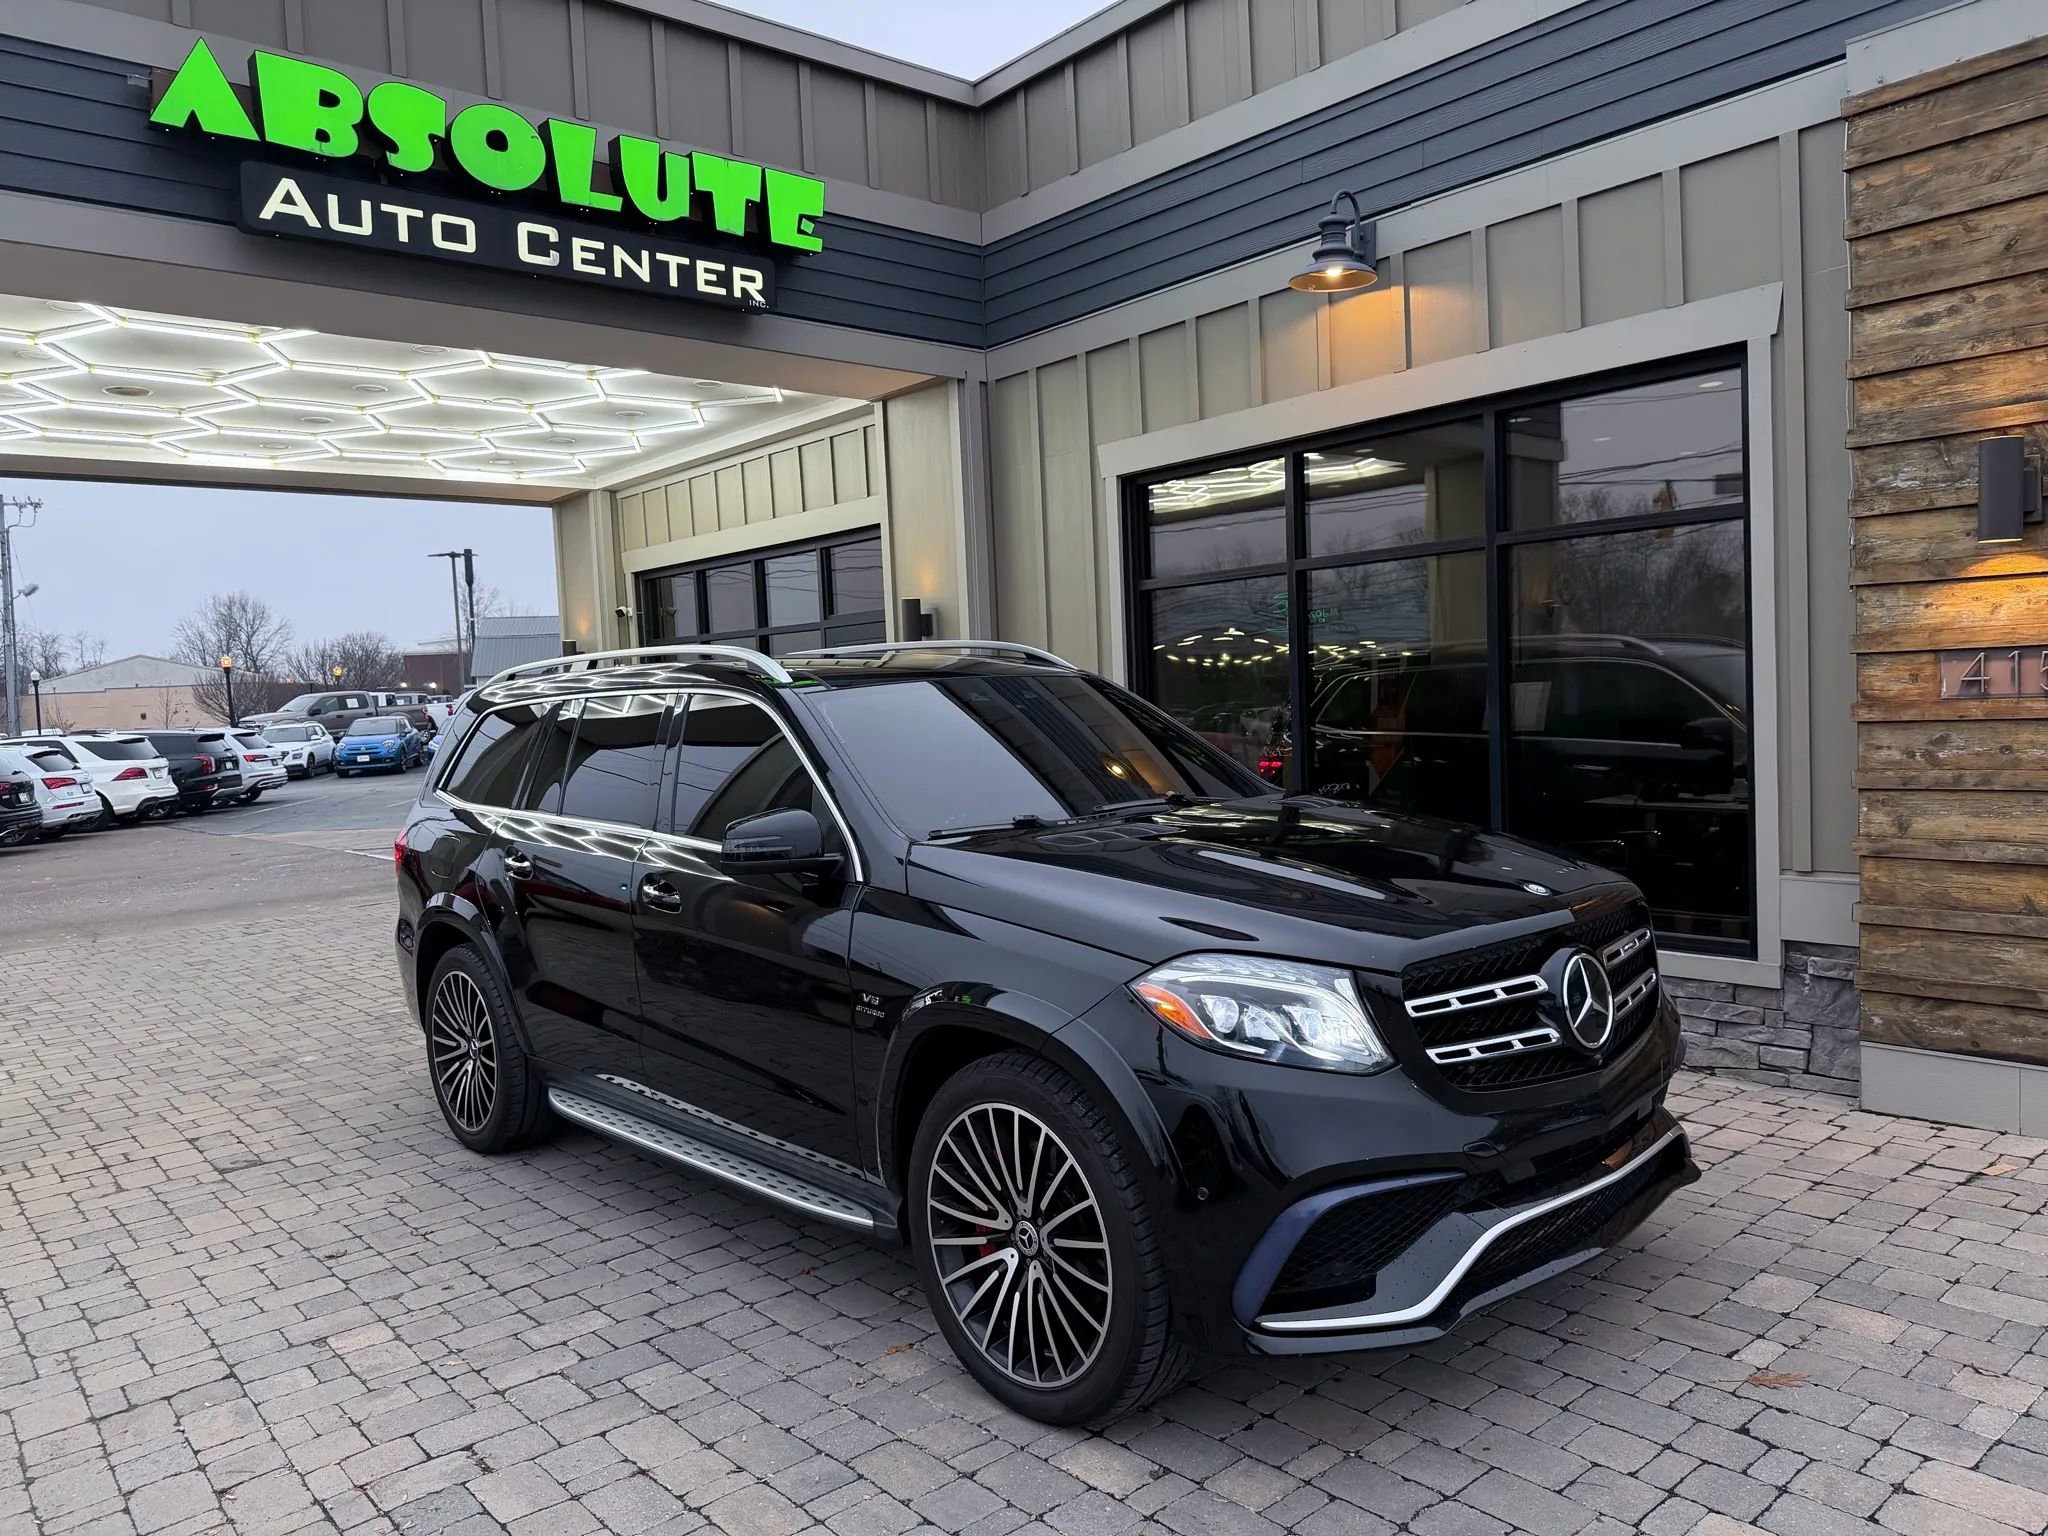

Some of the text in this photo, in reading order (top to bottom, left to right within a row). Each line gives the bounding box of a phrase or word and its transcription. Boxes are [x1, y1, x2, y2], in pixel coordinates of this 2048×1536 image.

[150, 37, 826, 253] ABSOLUTE
[258, 177, 767, 304] AUTO CENTER
[749, 299, 770, 309] INC.
